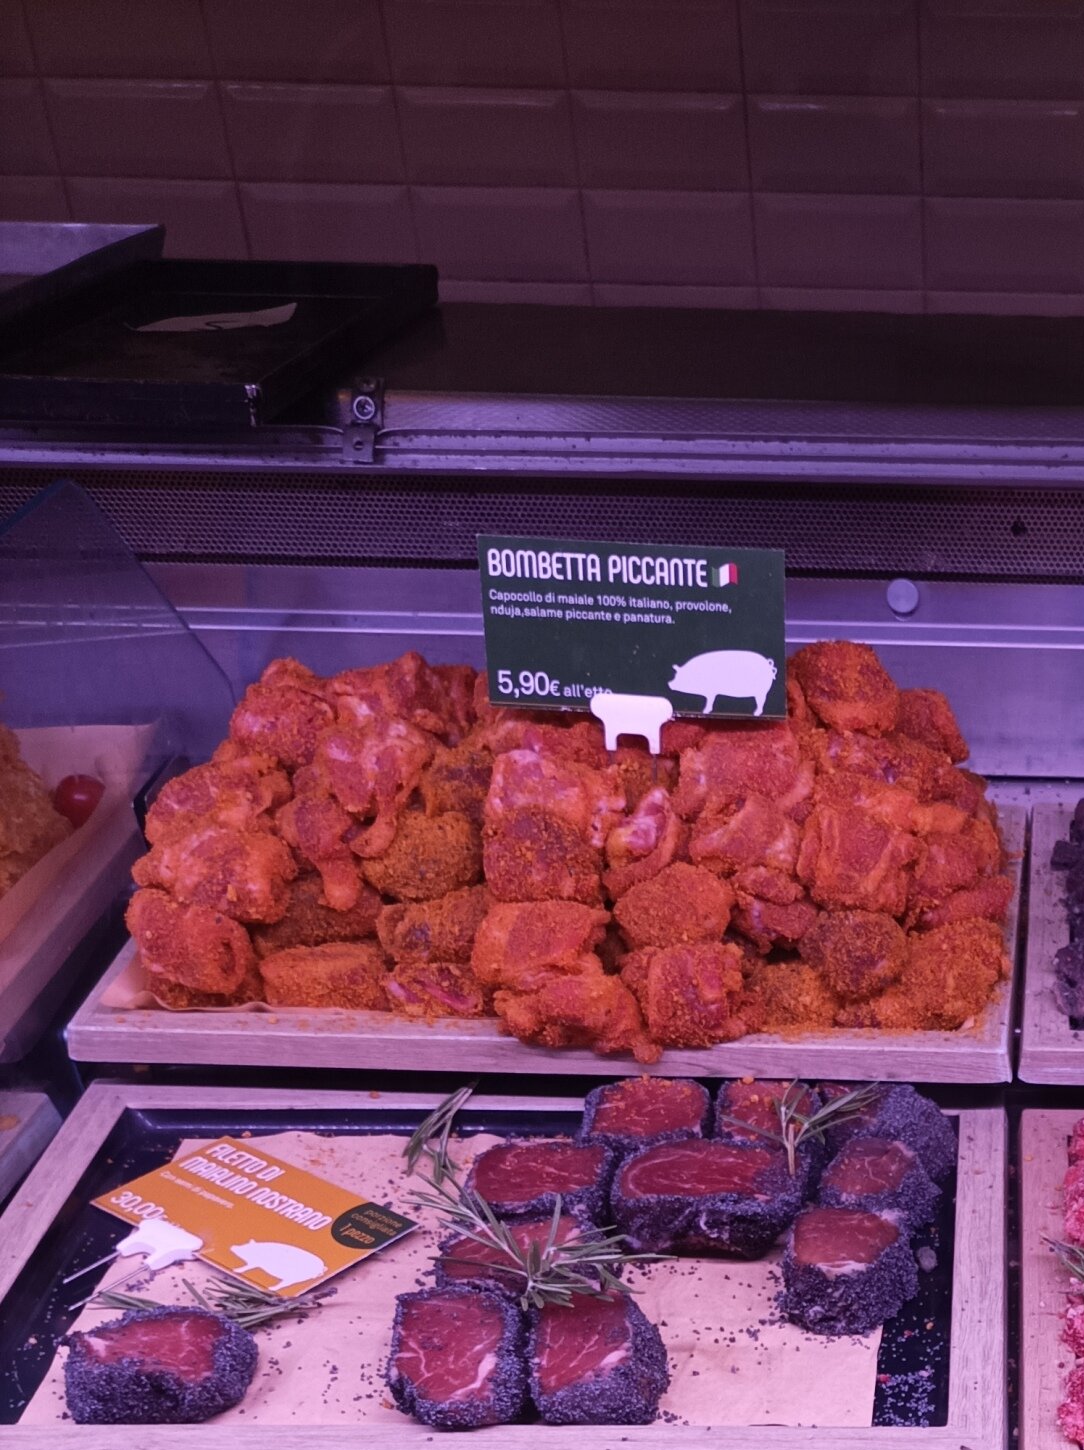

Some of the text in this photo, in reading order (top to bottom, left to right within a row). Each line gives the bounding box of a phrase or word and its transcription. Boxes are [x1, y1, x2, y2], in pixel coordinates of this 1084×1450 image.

[487, 548, 708, 588] BOMBETTA PICCANTE
[489, 589, 732, 615] Capocollo di maiale 100% italiano, provolone,
[565, 608, 612, 621] piccante
[614, 612, 621, 621] e
[623, 611, 675, 625] panatura.
[256, 1165, 285, 1181] DI
[179, 1156, 332, 1230] MAIALINO NOSTRANO
[341, 1228, 375, 1244] pezzo
